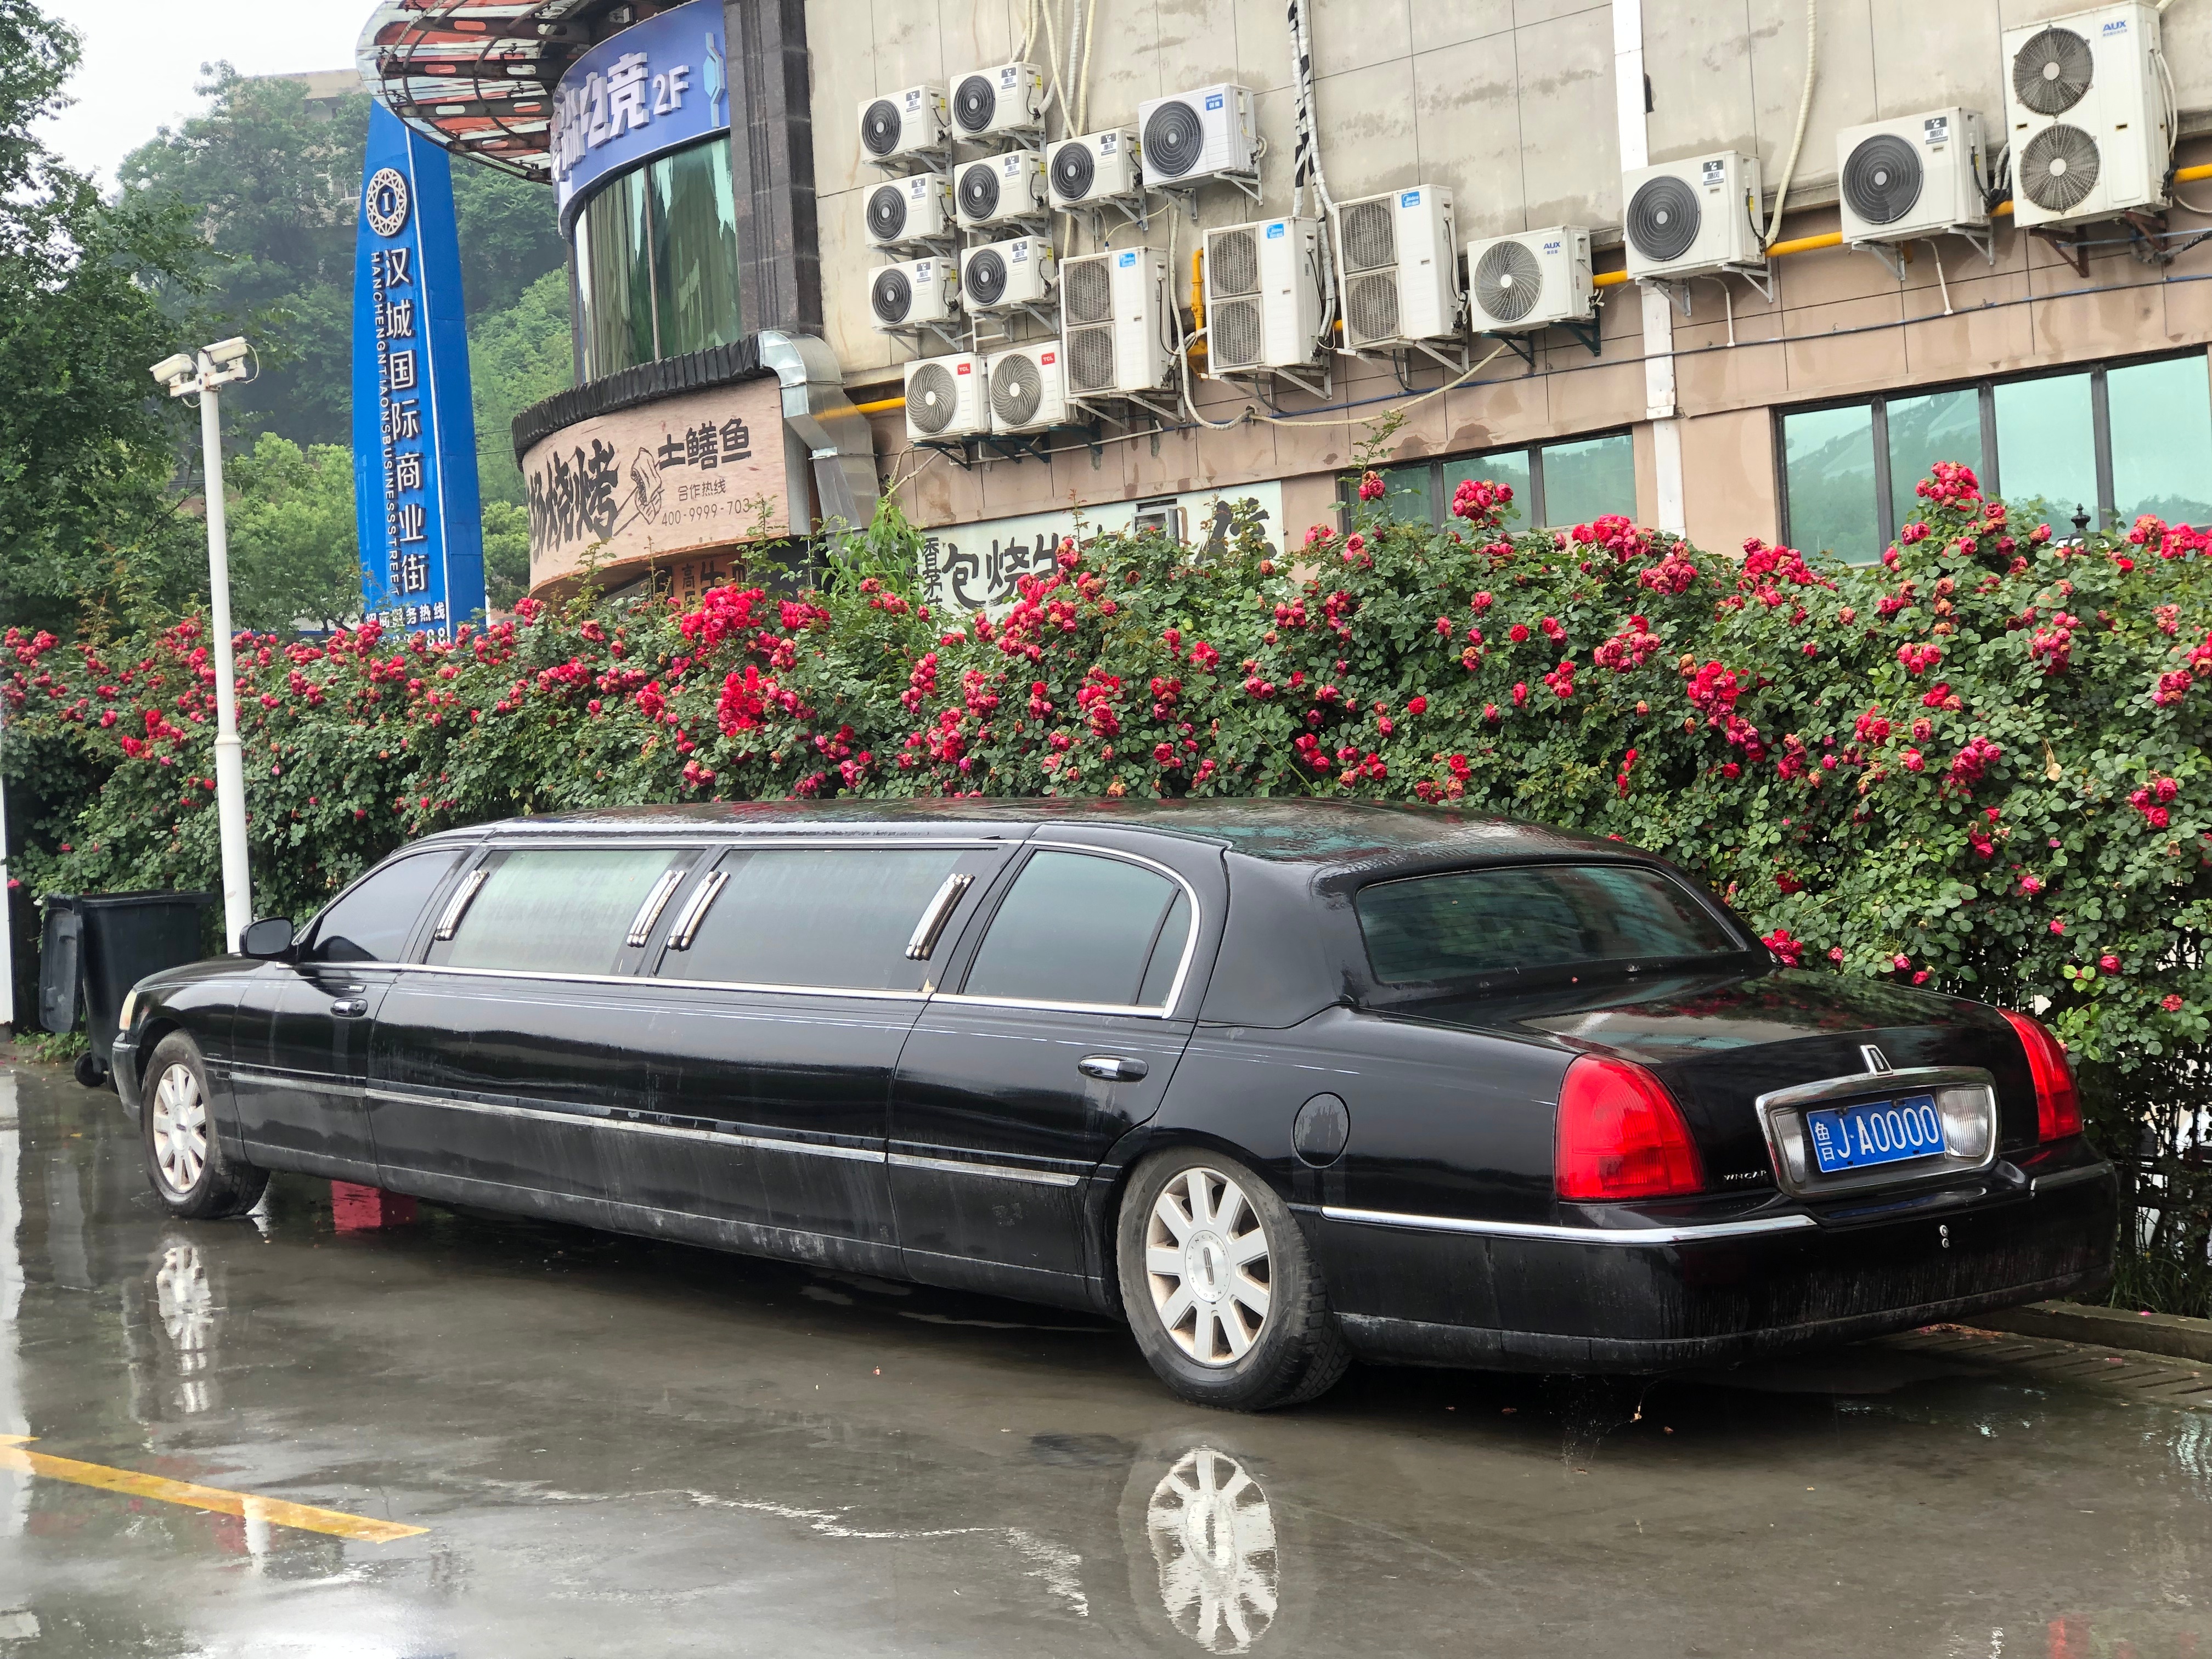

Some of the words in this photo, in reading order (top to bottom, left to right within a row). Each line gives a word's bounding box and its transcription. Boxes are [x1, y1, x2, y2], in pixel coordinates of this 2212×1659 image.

[2103, 20, 2126, 31] AUX
[652, 65, 689, 115] 2F
[1543, 241, 1561, 250] AUX
[385, 247, 426, 594] 汉城国际商业街
[658, 417, 752, 471] 土鳝鱼
[678, 478, 726, 501] 合作热线
[662, 498, 751, 527] 400-9999-703
